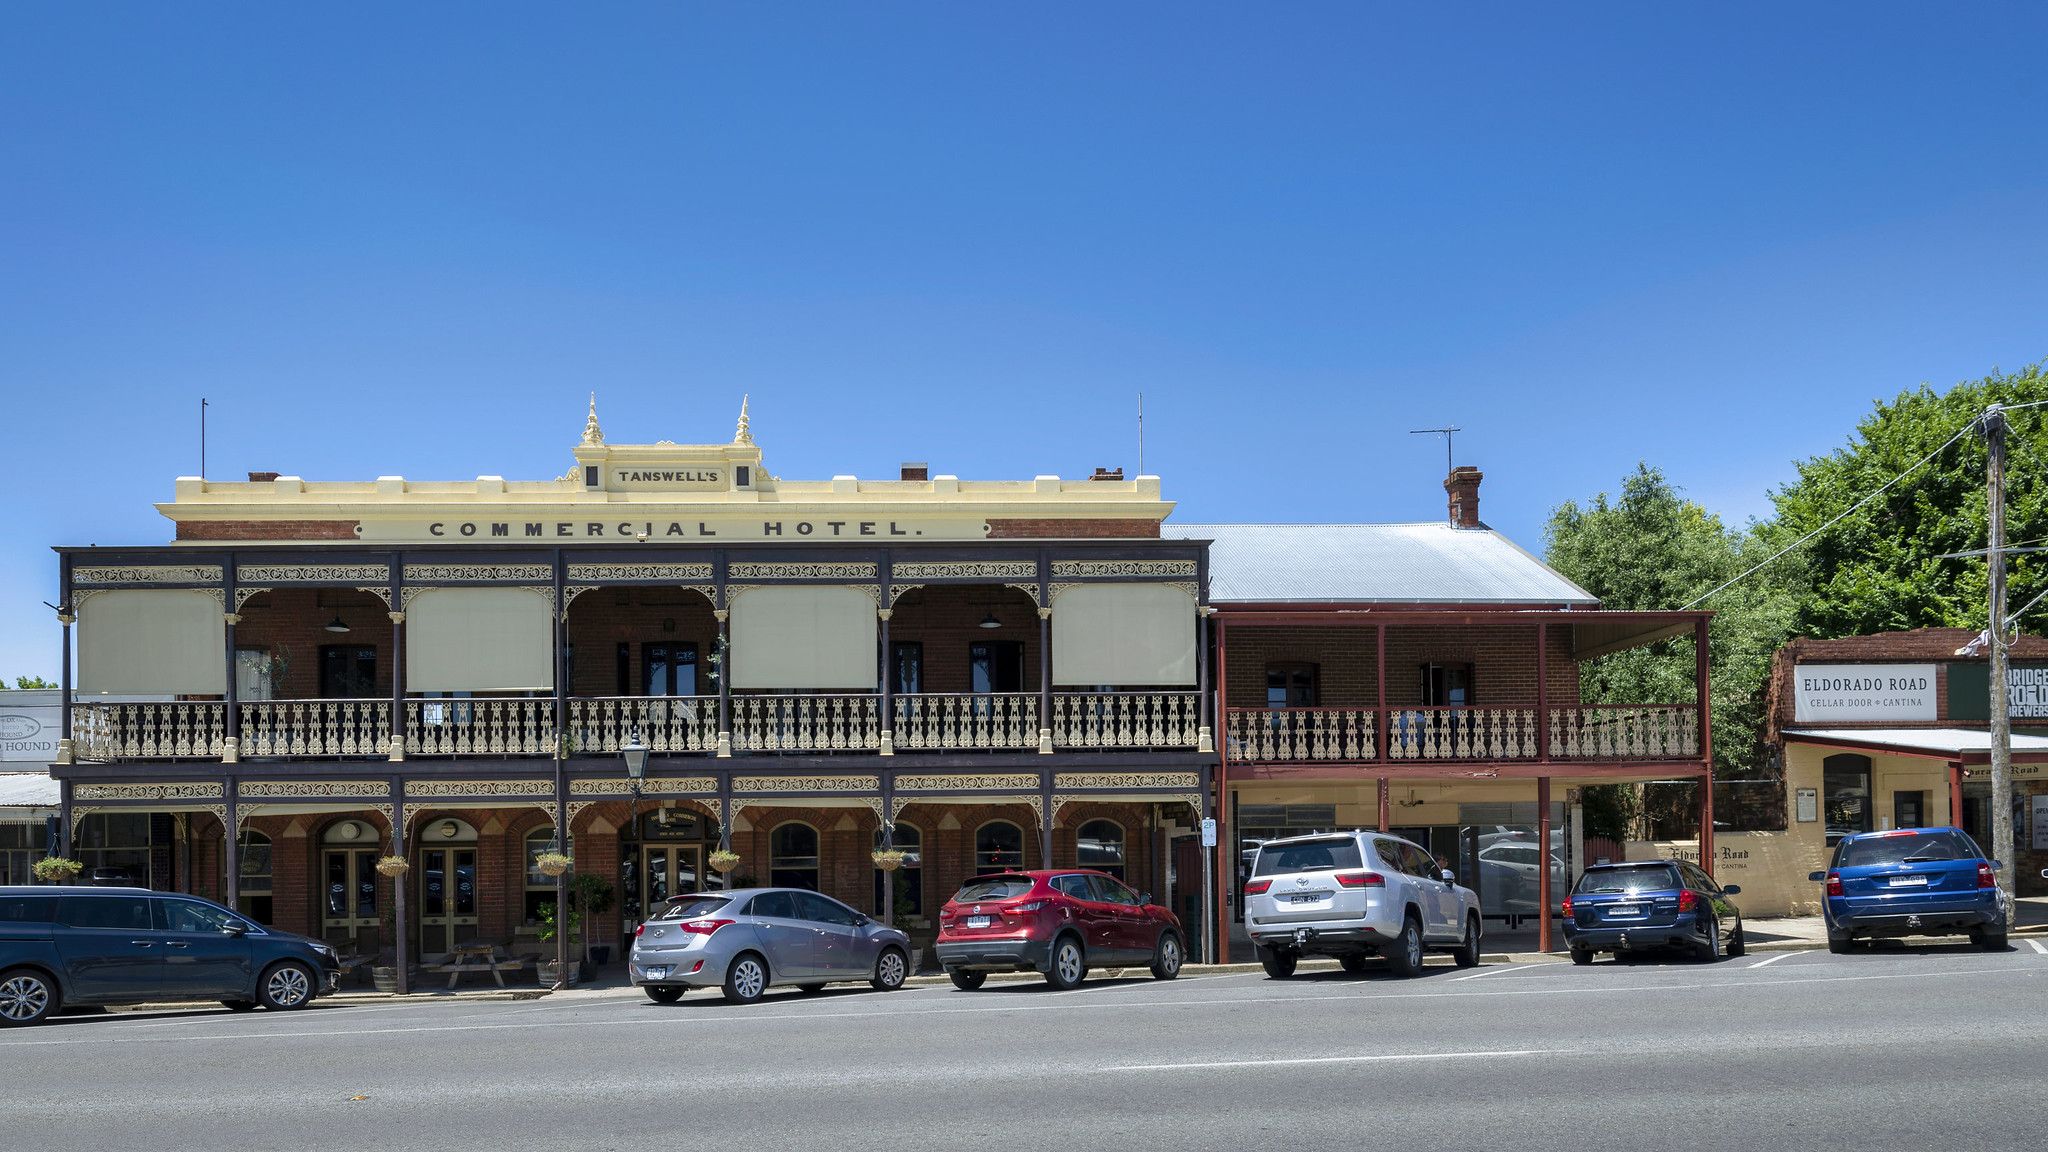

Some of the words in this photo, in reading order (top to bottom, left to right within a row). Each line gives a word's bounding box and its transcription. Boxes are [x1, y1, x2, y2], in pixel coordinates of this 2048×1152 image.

[618, 472, 718, 482] TANSWELL'S
[429, 522, 716, 536] COMMERCIAL
[1804, 678, 1882, 691] ELDORADO
[1889, 678, 1927, 690] ROAD
[1810, 698, 1845, 707] CELLAR
[1848, 698, 1872, 707] DOOR
[1883, 698, 1922, 706] CANTINA
[5, 742, 51, 751] HOUND
[1203, 821, 1215, 829] 2P
[1721, 846, 1749, 860] Road
